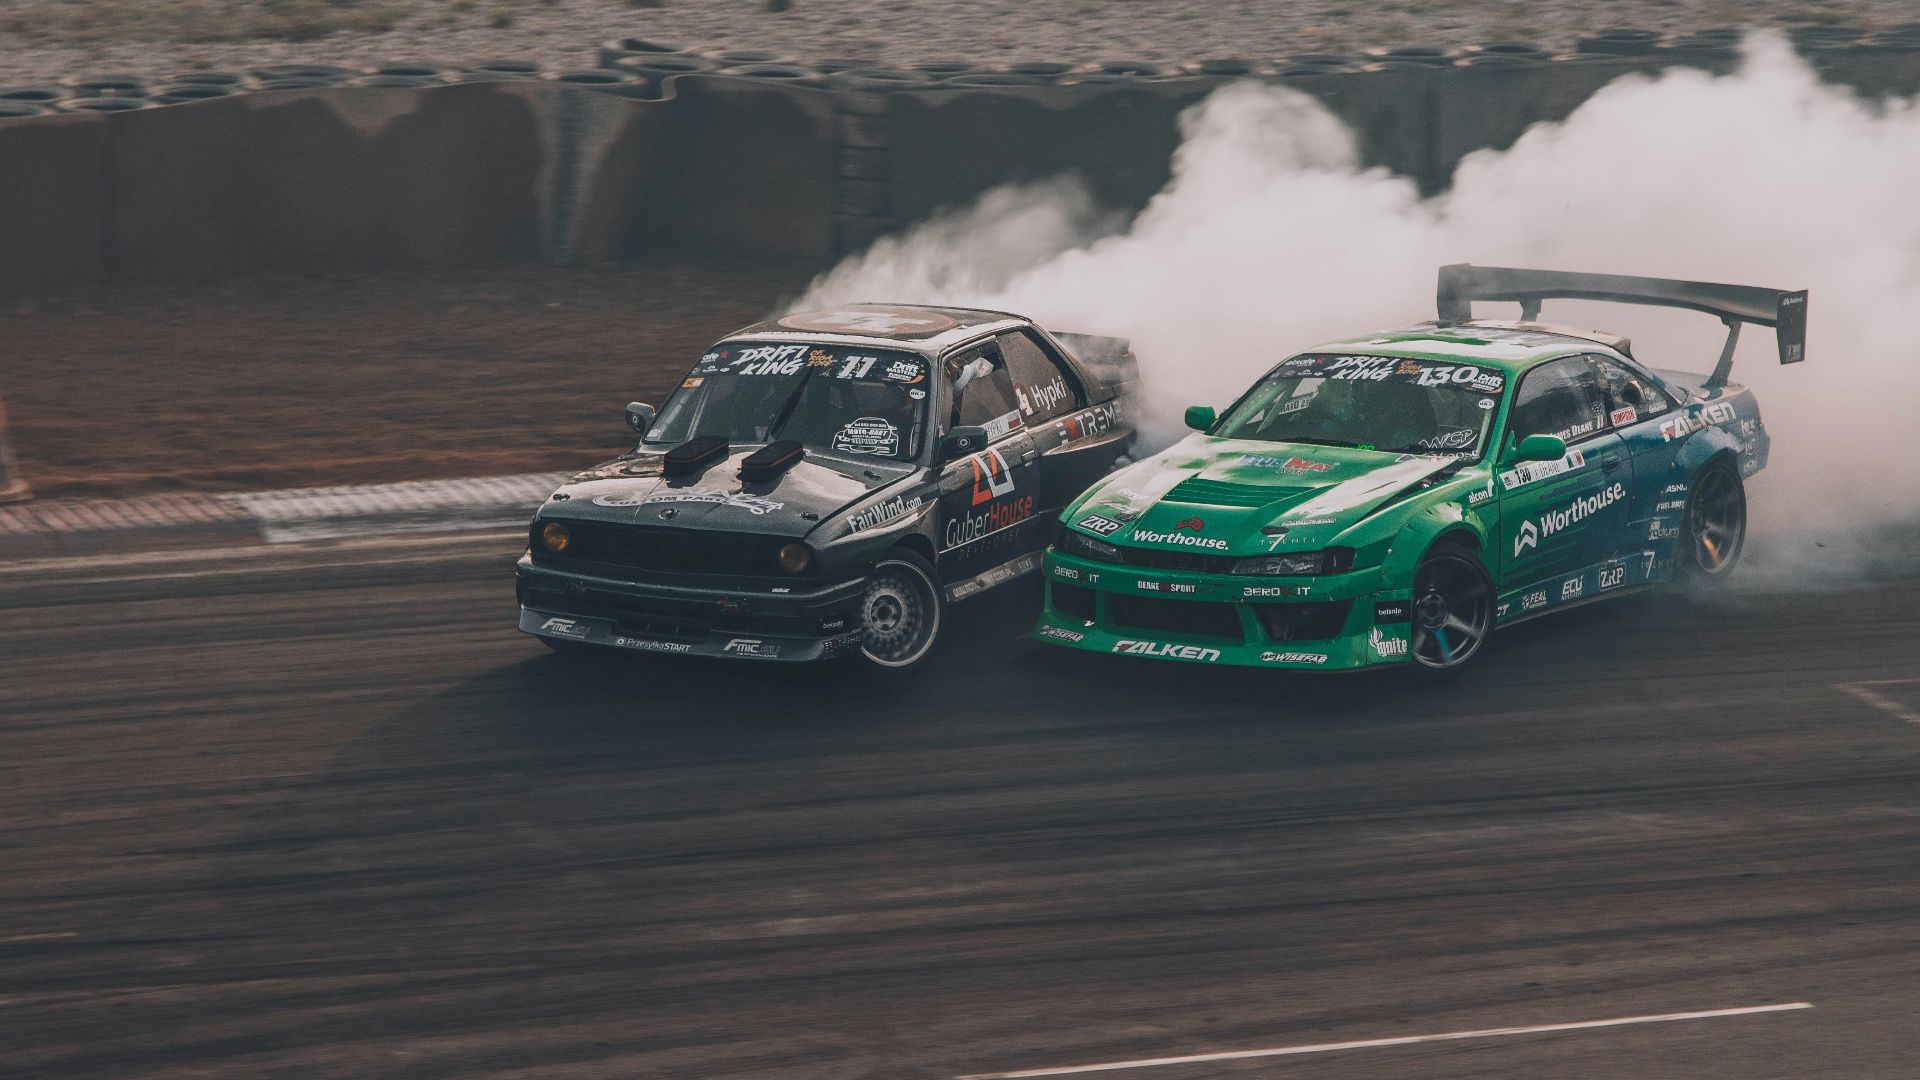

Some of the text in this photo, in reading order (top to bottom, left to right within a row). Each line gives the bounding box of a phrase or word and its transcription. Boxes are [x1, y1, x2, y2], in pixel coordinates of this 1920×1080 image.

[738, 358, 806, 376] KING
[1332, 366, 1396, 382] KING
[1417, 366, 1479, 386] 130
[1031, 376, 1067, 411] Hypki
[1659, 402, 1736, 443] FALKEN
[1514, 468, 1532, 485] 130
[1468, 490, 1489, 503] alcon
[847, 495, 922, 533] FairWind.com
[1540, 482, 1626, 539] Worthouse.
[1079, 515, 1119, 533] ZRP
[1133, 529, 1230, 551] Worthouse.
[1563, 575, 1584, 595] ECU
[1600, 567, 1624, 588] ZRP
[1111, 639, 1221, 662] FALKEN
